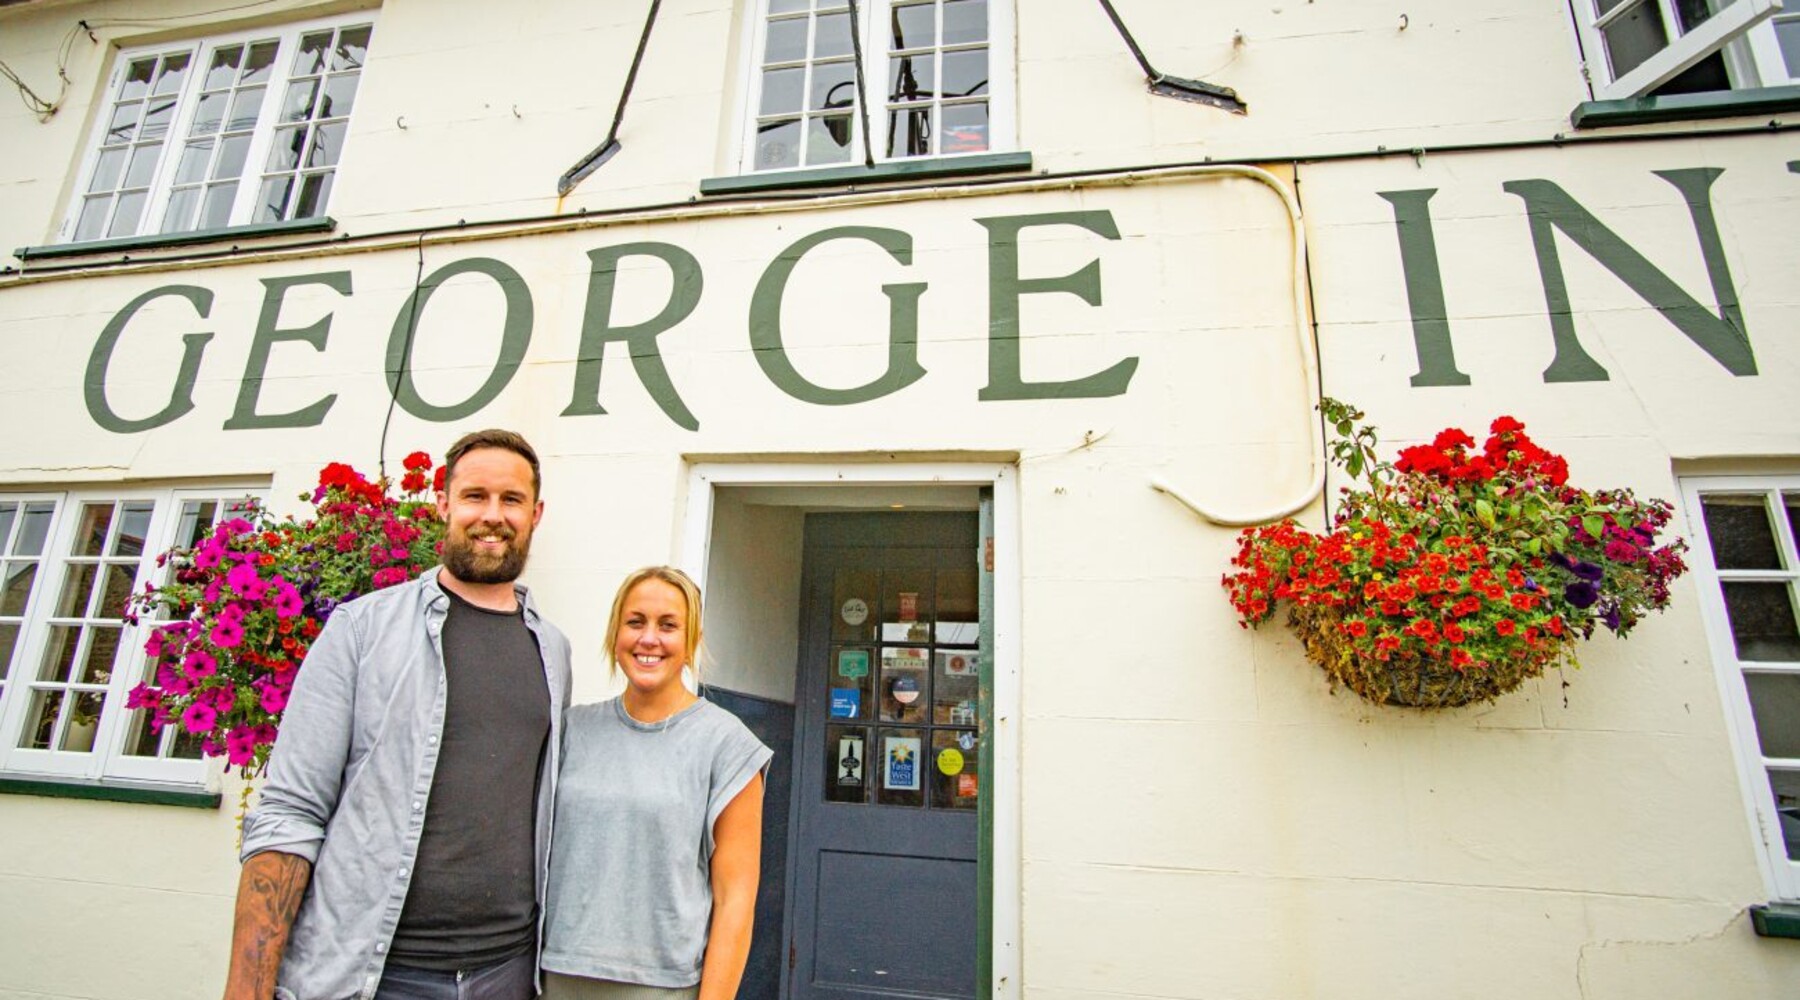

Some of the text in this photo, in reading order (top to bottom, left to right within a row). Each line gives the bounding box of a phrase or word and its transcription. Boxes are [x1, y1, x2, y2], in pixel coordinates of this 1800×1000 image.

[84, 160, 1800, 433] GEORGE IN
[891, 772, 912, 780] West
